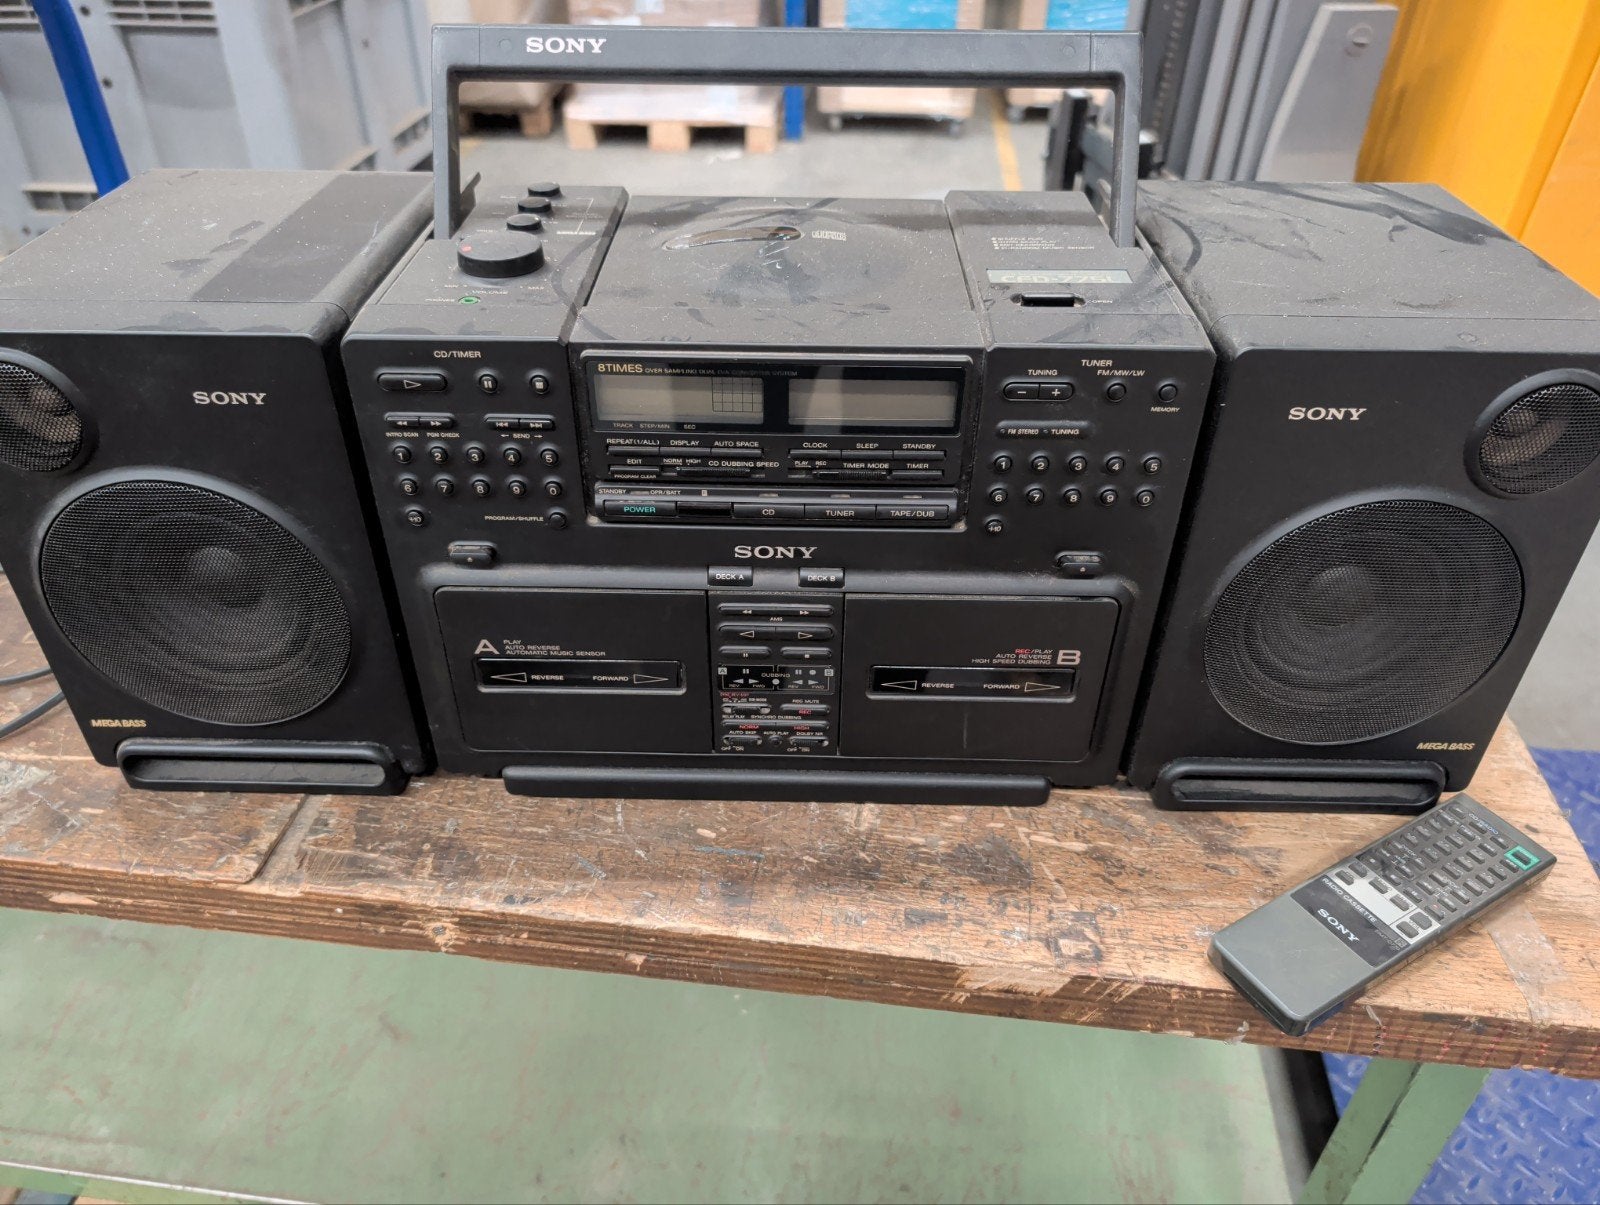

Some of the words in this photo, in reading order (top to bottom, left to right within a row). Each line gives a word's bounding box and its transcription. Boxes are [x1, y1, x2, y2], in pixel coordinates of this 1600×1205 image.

[526, 37, 607, 53] SONY
[1097, 369, 1145, 377] FM/MW/LW
[192, 391, 267, 405] SONY
[1288, 407, 1367, 421] SONY
[435, 453, 442, 461] 2
[508, 454, 516, 462] 4
[1112, 463, 1119, 471] 4
[1150, 463, 1158, 471] 5
[404, 485, 411, 493] 6
[440, 485, 448, 493] 7
[477, 485, 484, 493] 8
[512, 486, 520, 494] 9
[549, 487, 556, 495] 0
[995, 494, 1002, 502] 6
[734, 545, 817, 559] SONY
[474, 639, 500, 654] A
[1056, 650, 1081, 665] B
[91, 719, 122, 727] MEGA
[122, 719, 147, 728] BASS
[1416, 742, 1447, 750] MEGA
[1322, 877, 1344, 896] RADIO
[1343, 894, 1377, 923] CASSETTE
[1317, 908, 1360, 942] SONY
